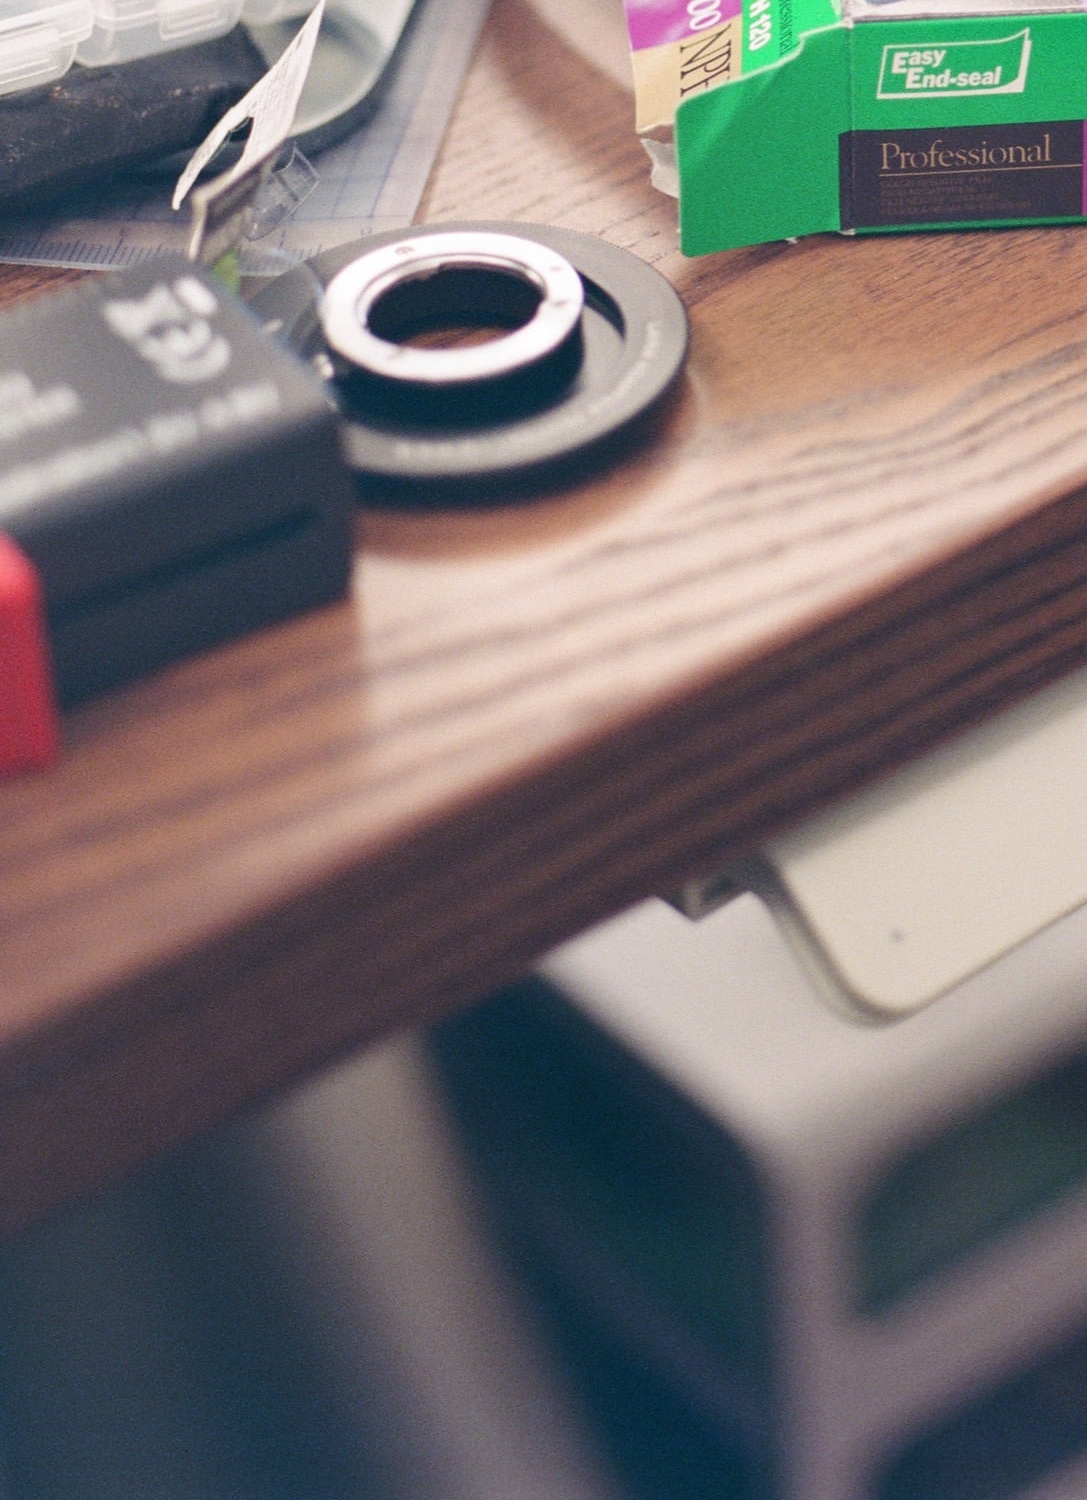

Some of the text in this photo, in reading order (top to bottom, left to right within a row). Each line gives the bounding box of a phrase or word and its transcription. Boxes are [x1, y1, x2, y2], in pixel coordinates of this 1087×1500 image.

[748, 13, 773, 51] 120
[891, 49, 947, 74] Easy
[905, 66, 1002, 90] End-seal
[880, 134, 1051, 170] Professional
